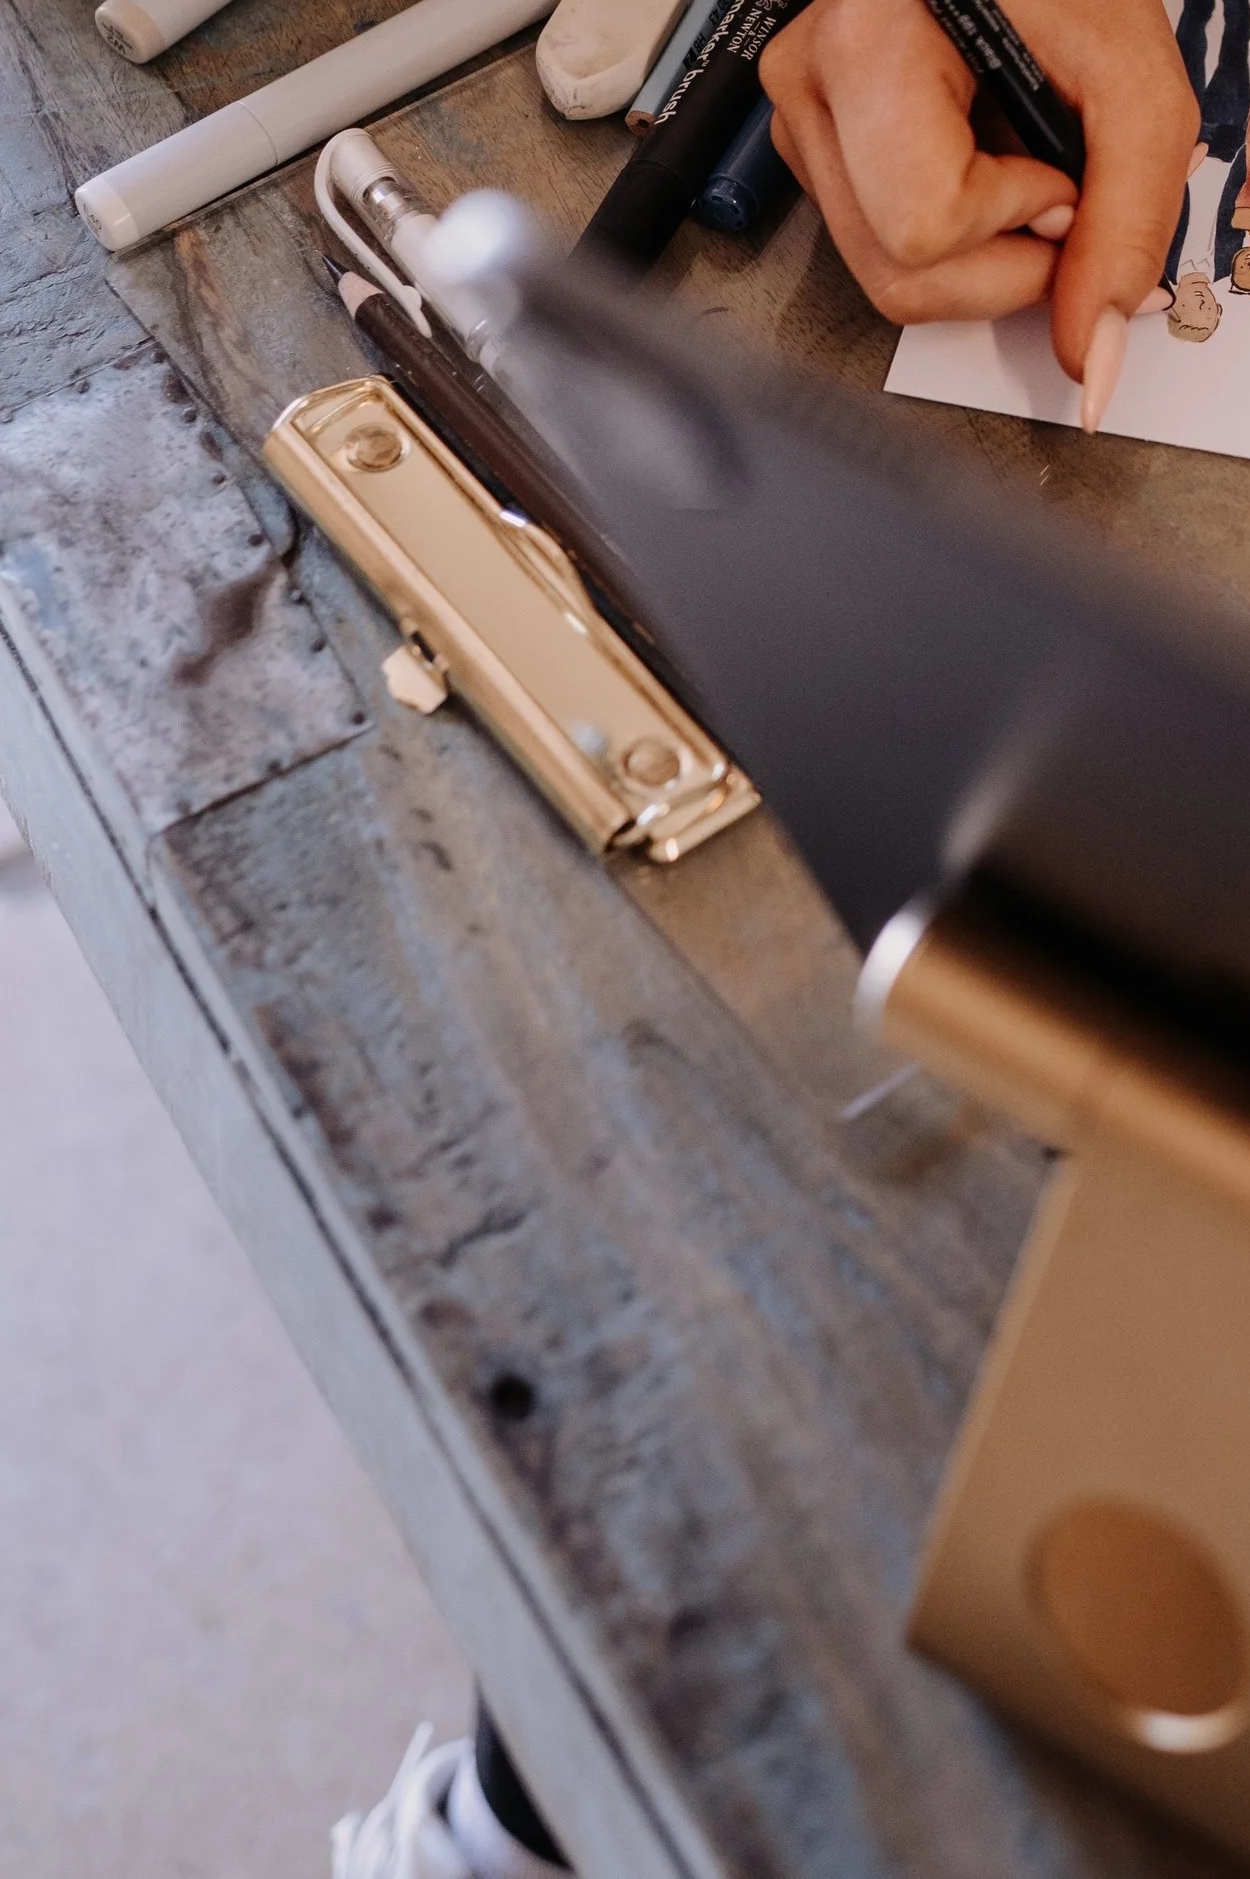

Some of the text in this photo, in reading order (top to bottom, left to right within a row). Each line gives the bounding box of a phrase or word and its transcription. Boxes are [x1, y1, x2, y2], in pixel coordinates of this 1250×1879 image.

[693, 33, 707, 55] HB
[727, 8, 763, 53] NEWTON
[740, 17, 776, 61] WINSOR
[656, 69, 704, 125] brush
